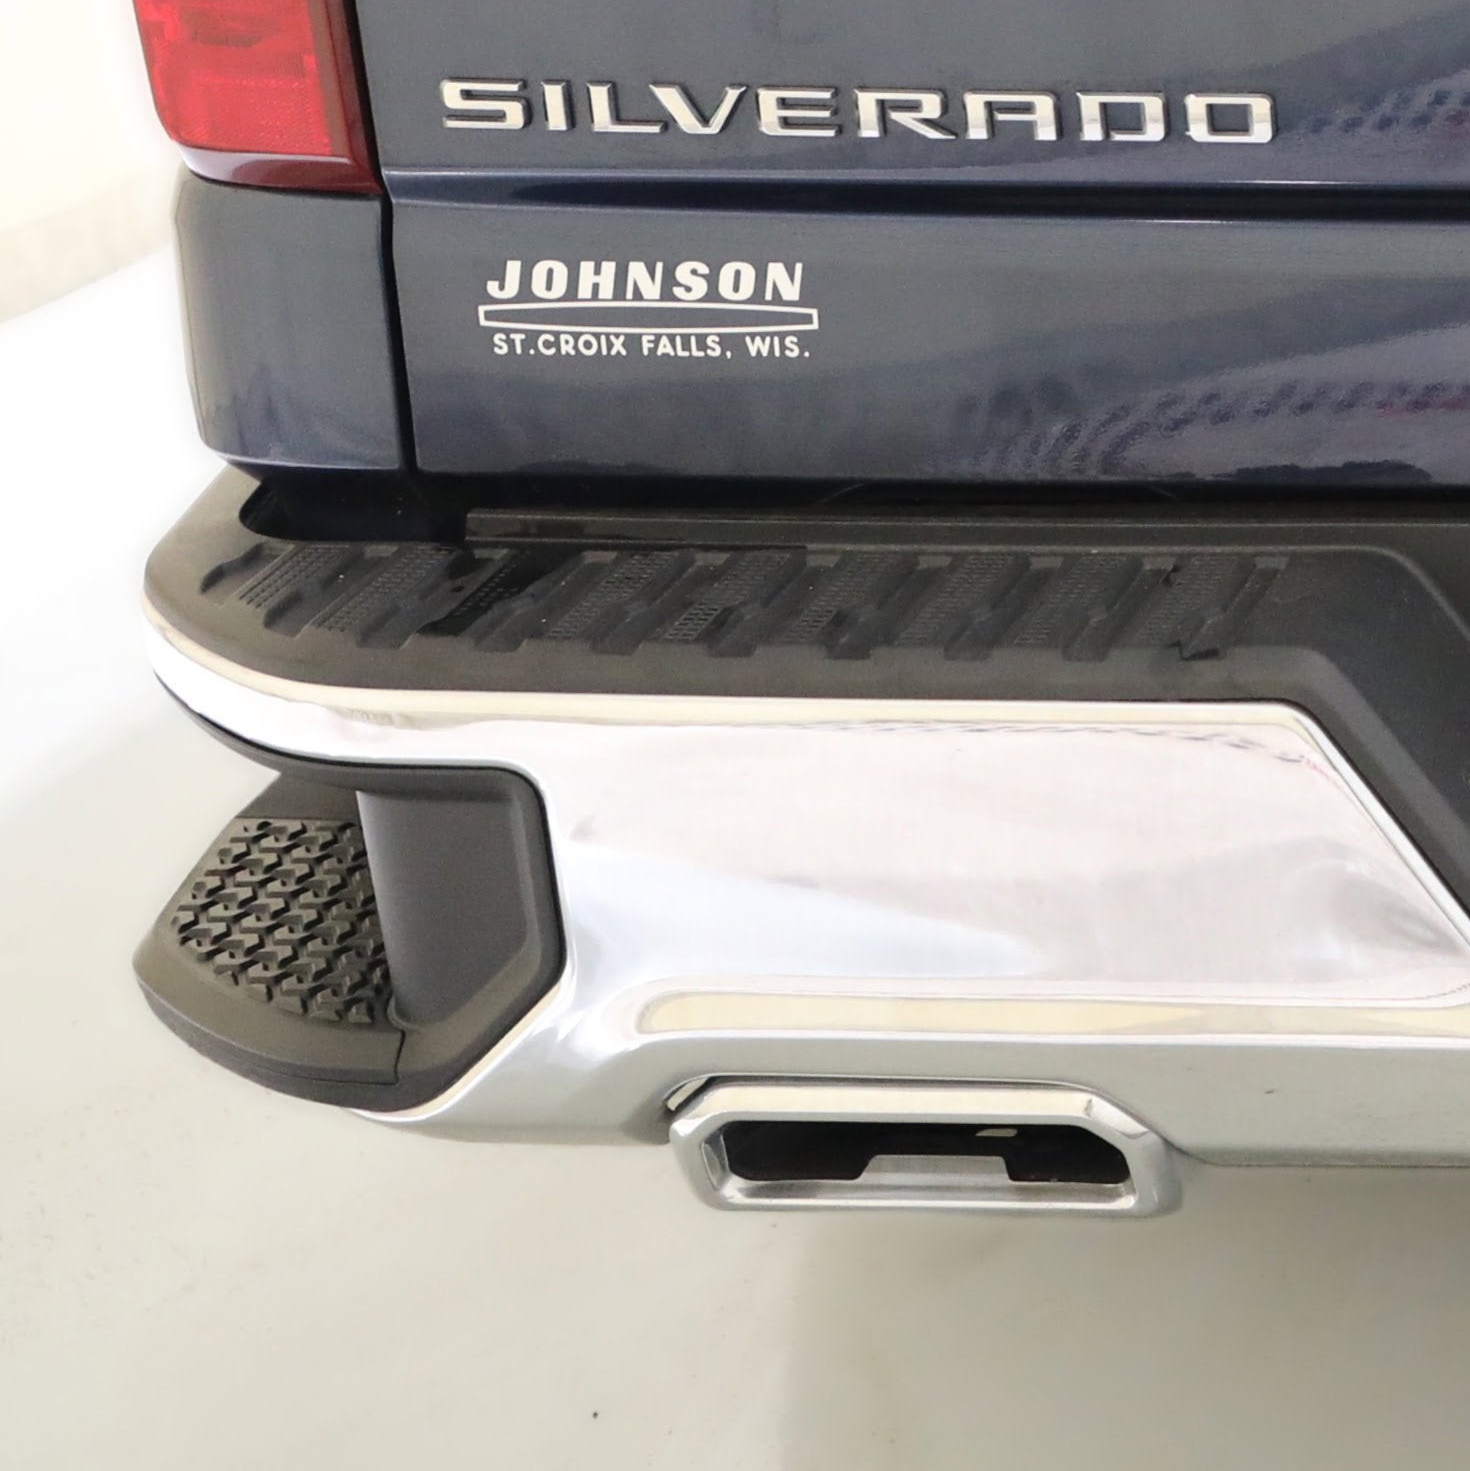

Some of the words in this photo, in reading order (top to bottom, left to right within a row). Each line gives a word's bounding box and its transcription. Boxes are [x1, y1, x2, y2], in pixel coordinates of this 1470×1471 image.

[438, 77, 1277, 144] SILVERADO
[486, 260, 803, 301] JOHNSON
[641, 334, 732, 359] FALLS,
[744, 336, 810, 358] WIS.
